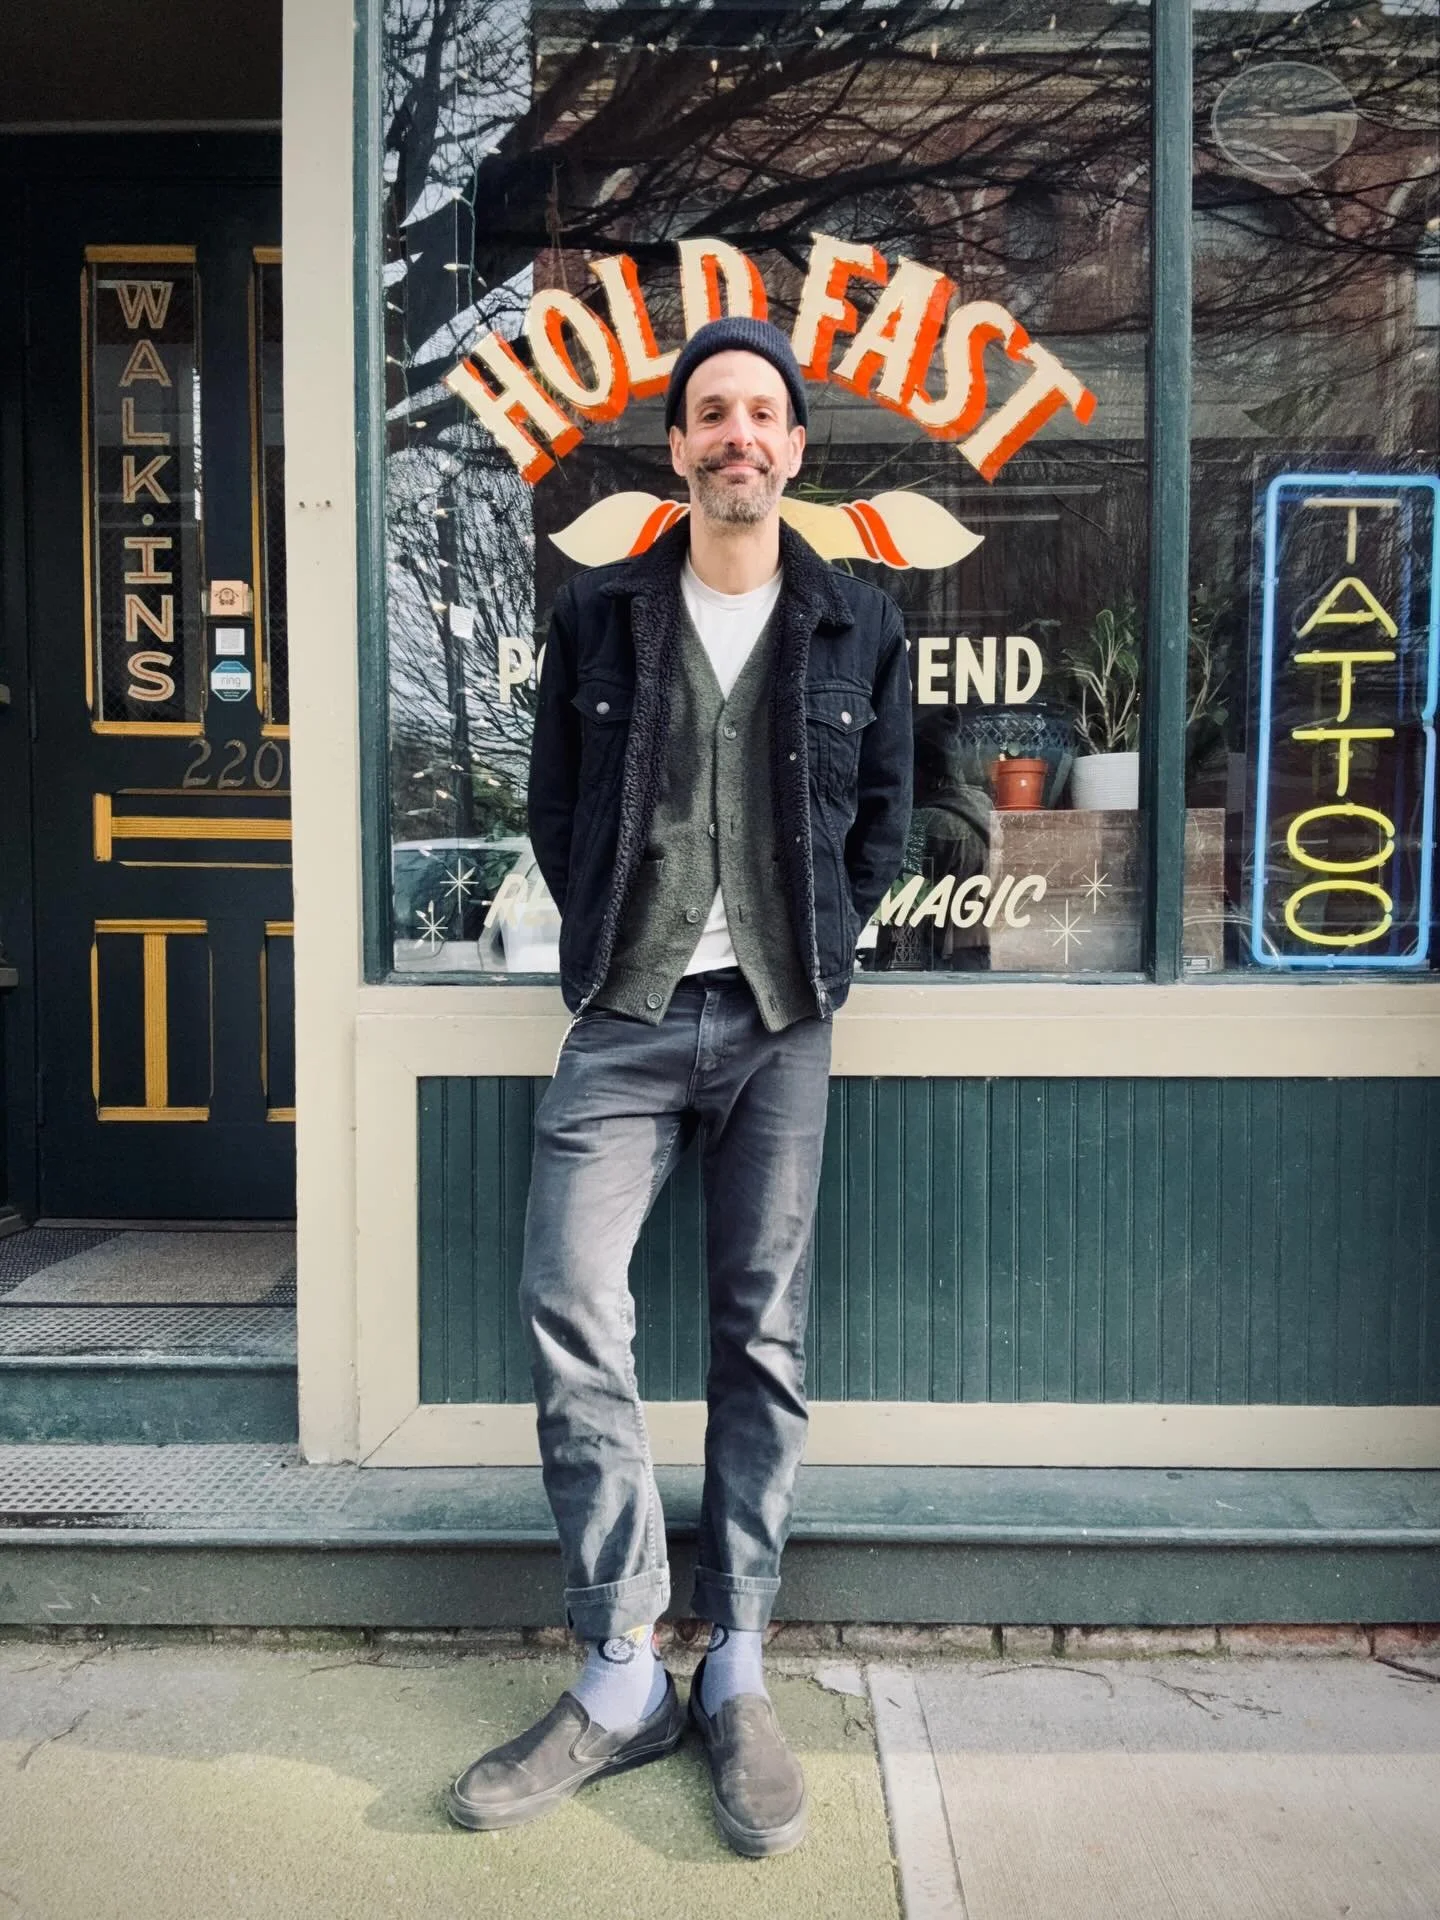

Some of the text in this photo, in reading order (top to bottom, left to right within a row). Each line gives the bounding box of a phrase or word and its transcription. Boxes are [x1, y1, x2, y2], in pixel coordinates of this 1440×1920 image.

[443, 232, 1098, 484] HOLD FAST
[905, 636, 1043, 705] END
[1284, 497, 1402, 946] TATTOO
[182, 739, 284, 789] 220
[880, 874, 1048, 929] MAGIC
